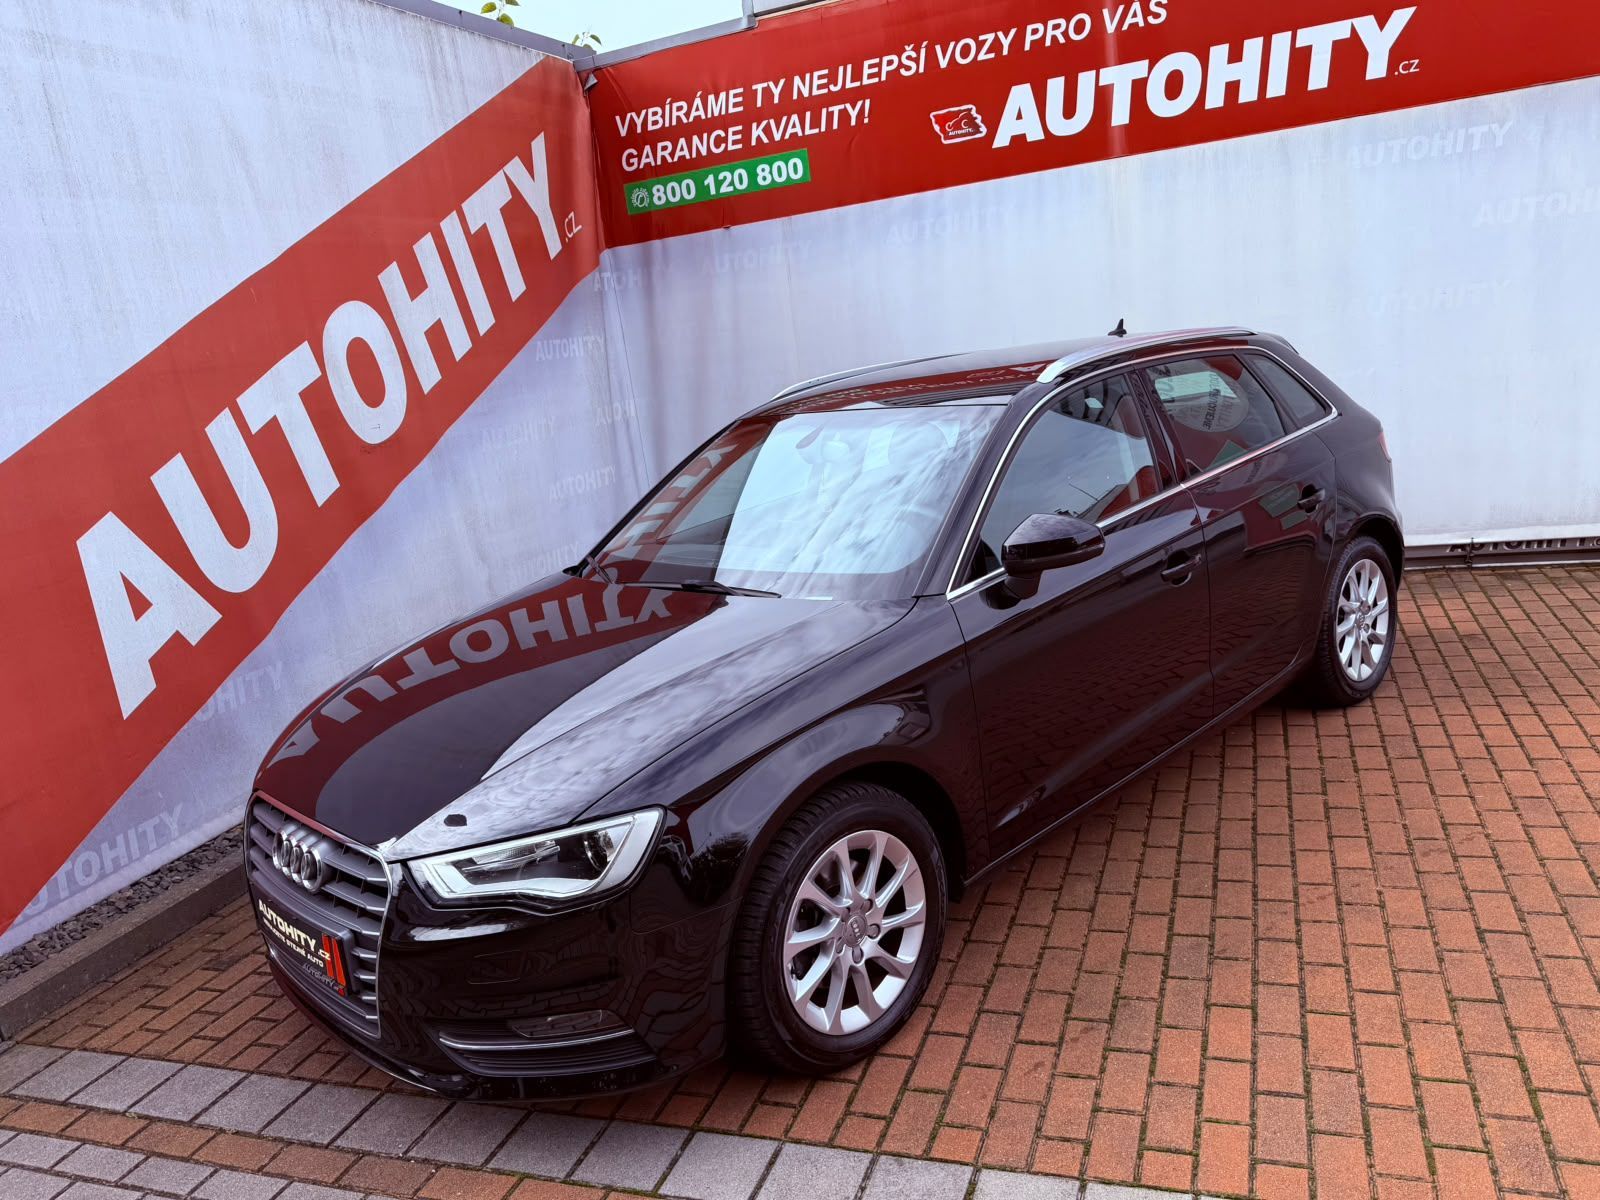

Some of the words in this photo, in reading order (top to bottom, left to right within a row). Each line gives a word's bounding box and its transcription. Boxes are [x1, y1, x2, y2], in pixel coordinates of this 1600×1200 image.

[615, 86, 744, 138] VYBÍRÁME
[751, 78, 784, 107] TY
[792, 40, 930, 100] NEJLEPŠÍ
[934, 27, 1018, 70] VOZY
[1023, 12, 1092, 52] PRO
[1102, 0, 1168, 34] VÁS
[621, 126, 744, 172] GARANCE
[750, 98, 871, 147] KVALITY!
[1347, 120, 1514, 169] AUTOHITY
[652, 178, 697, 206] 800
[703, 167, 749, 197] 120
[756, 156, 804, 186] 800
[15, 803, 184, 923] UTOHITY
[307, 952, 325, 969] AUTO
